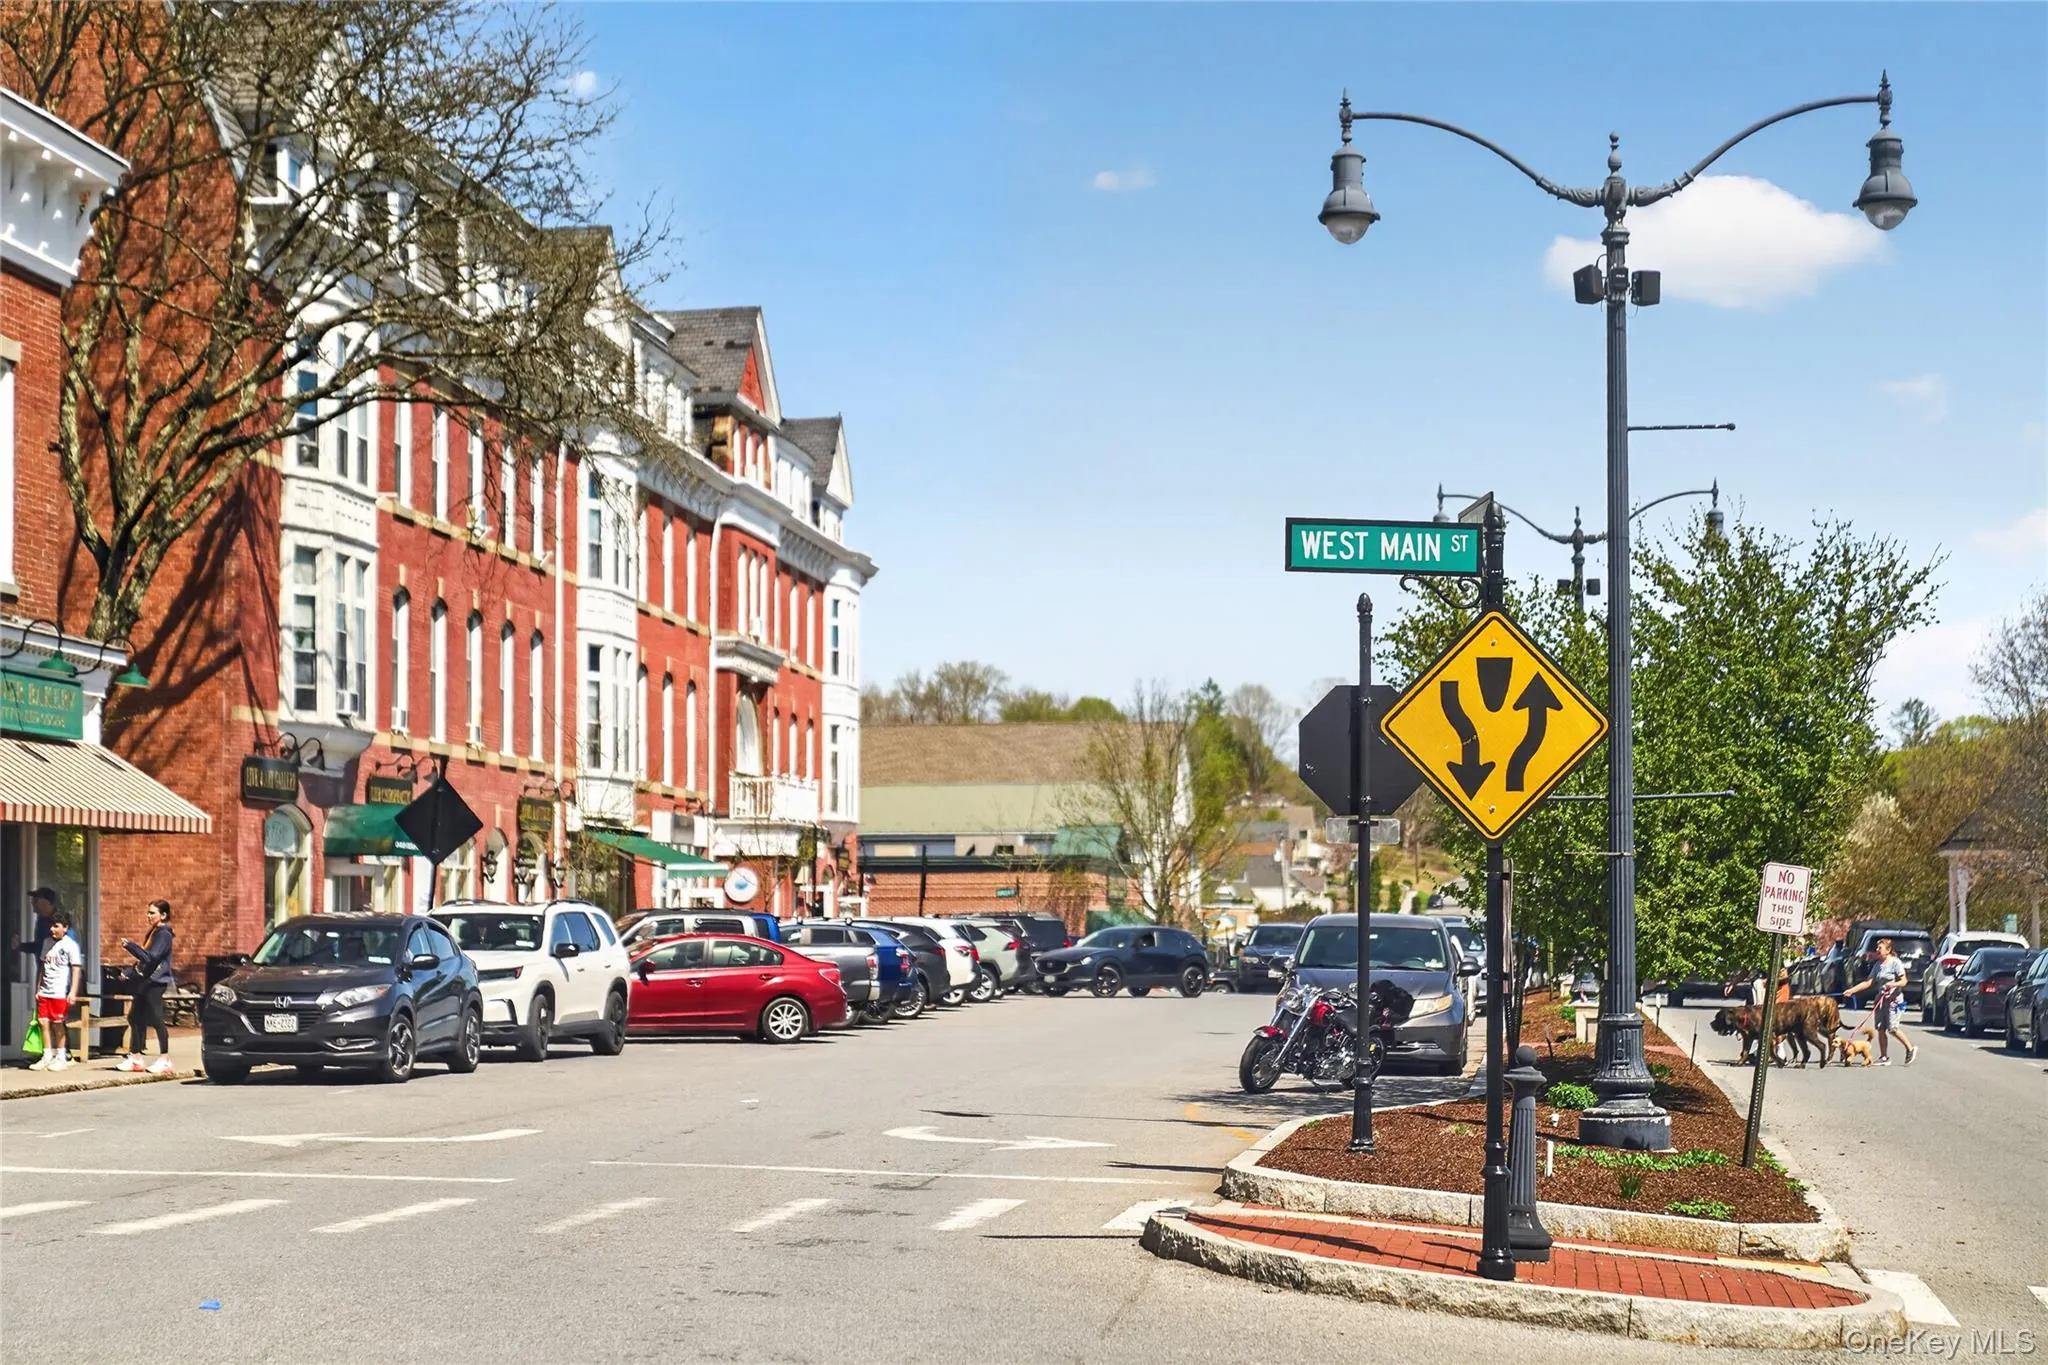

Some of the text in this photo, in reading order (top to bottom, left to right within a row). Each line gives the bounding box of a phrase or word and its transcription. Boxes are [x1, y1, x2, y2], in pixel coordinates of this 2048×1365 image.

[1301, 530, 1469, 562] WEST MAIN ST
[1778, 871, 1795, 885] NO
[1764, 886, 1804, 903] PARKING
[1771, 904, 1794, 915] THIS
[1769, 916, 1792, 928] SIDE
